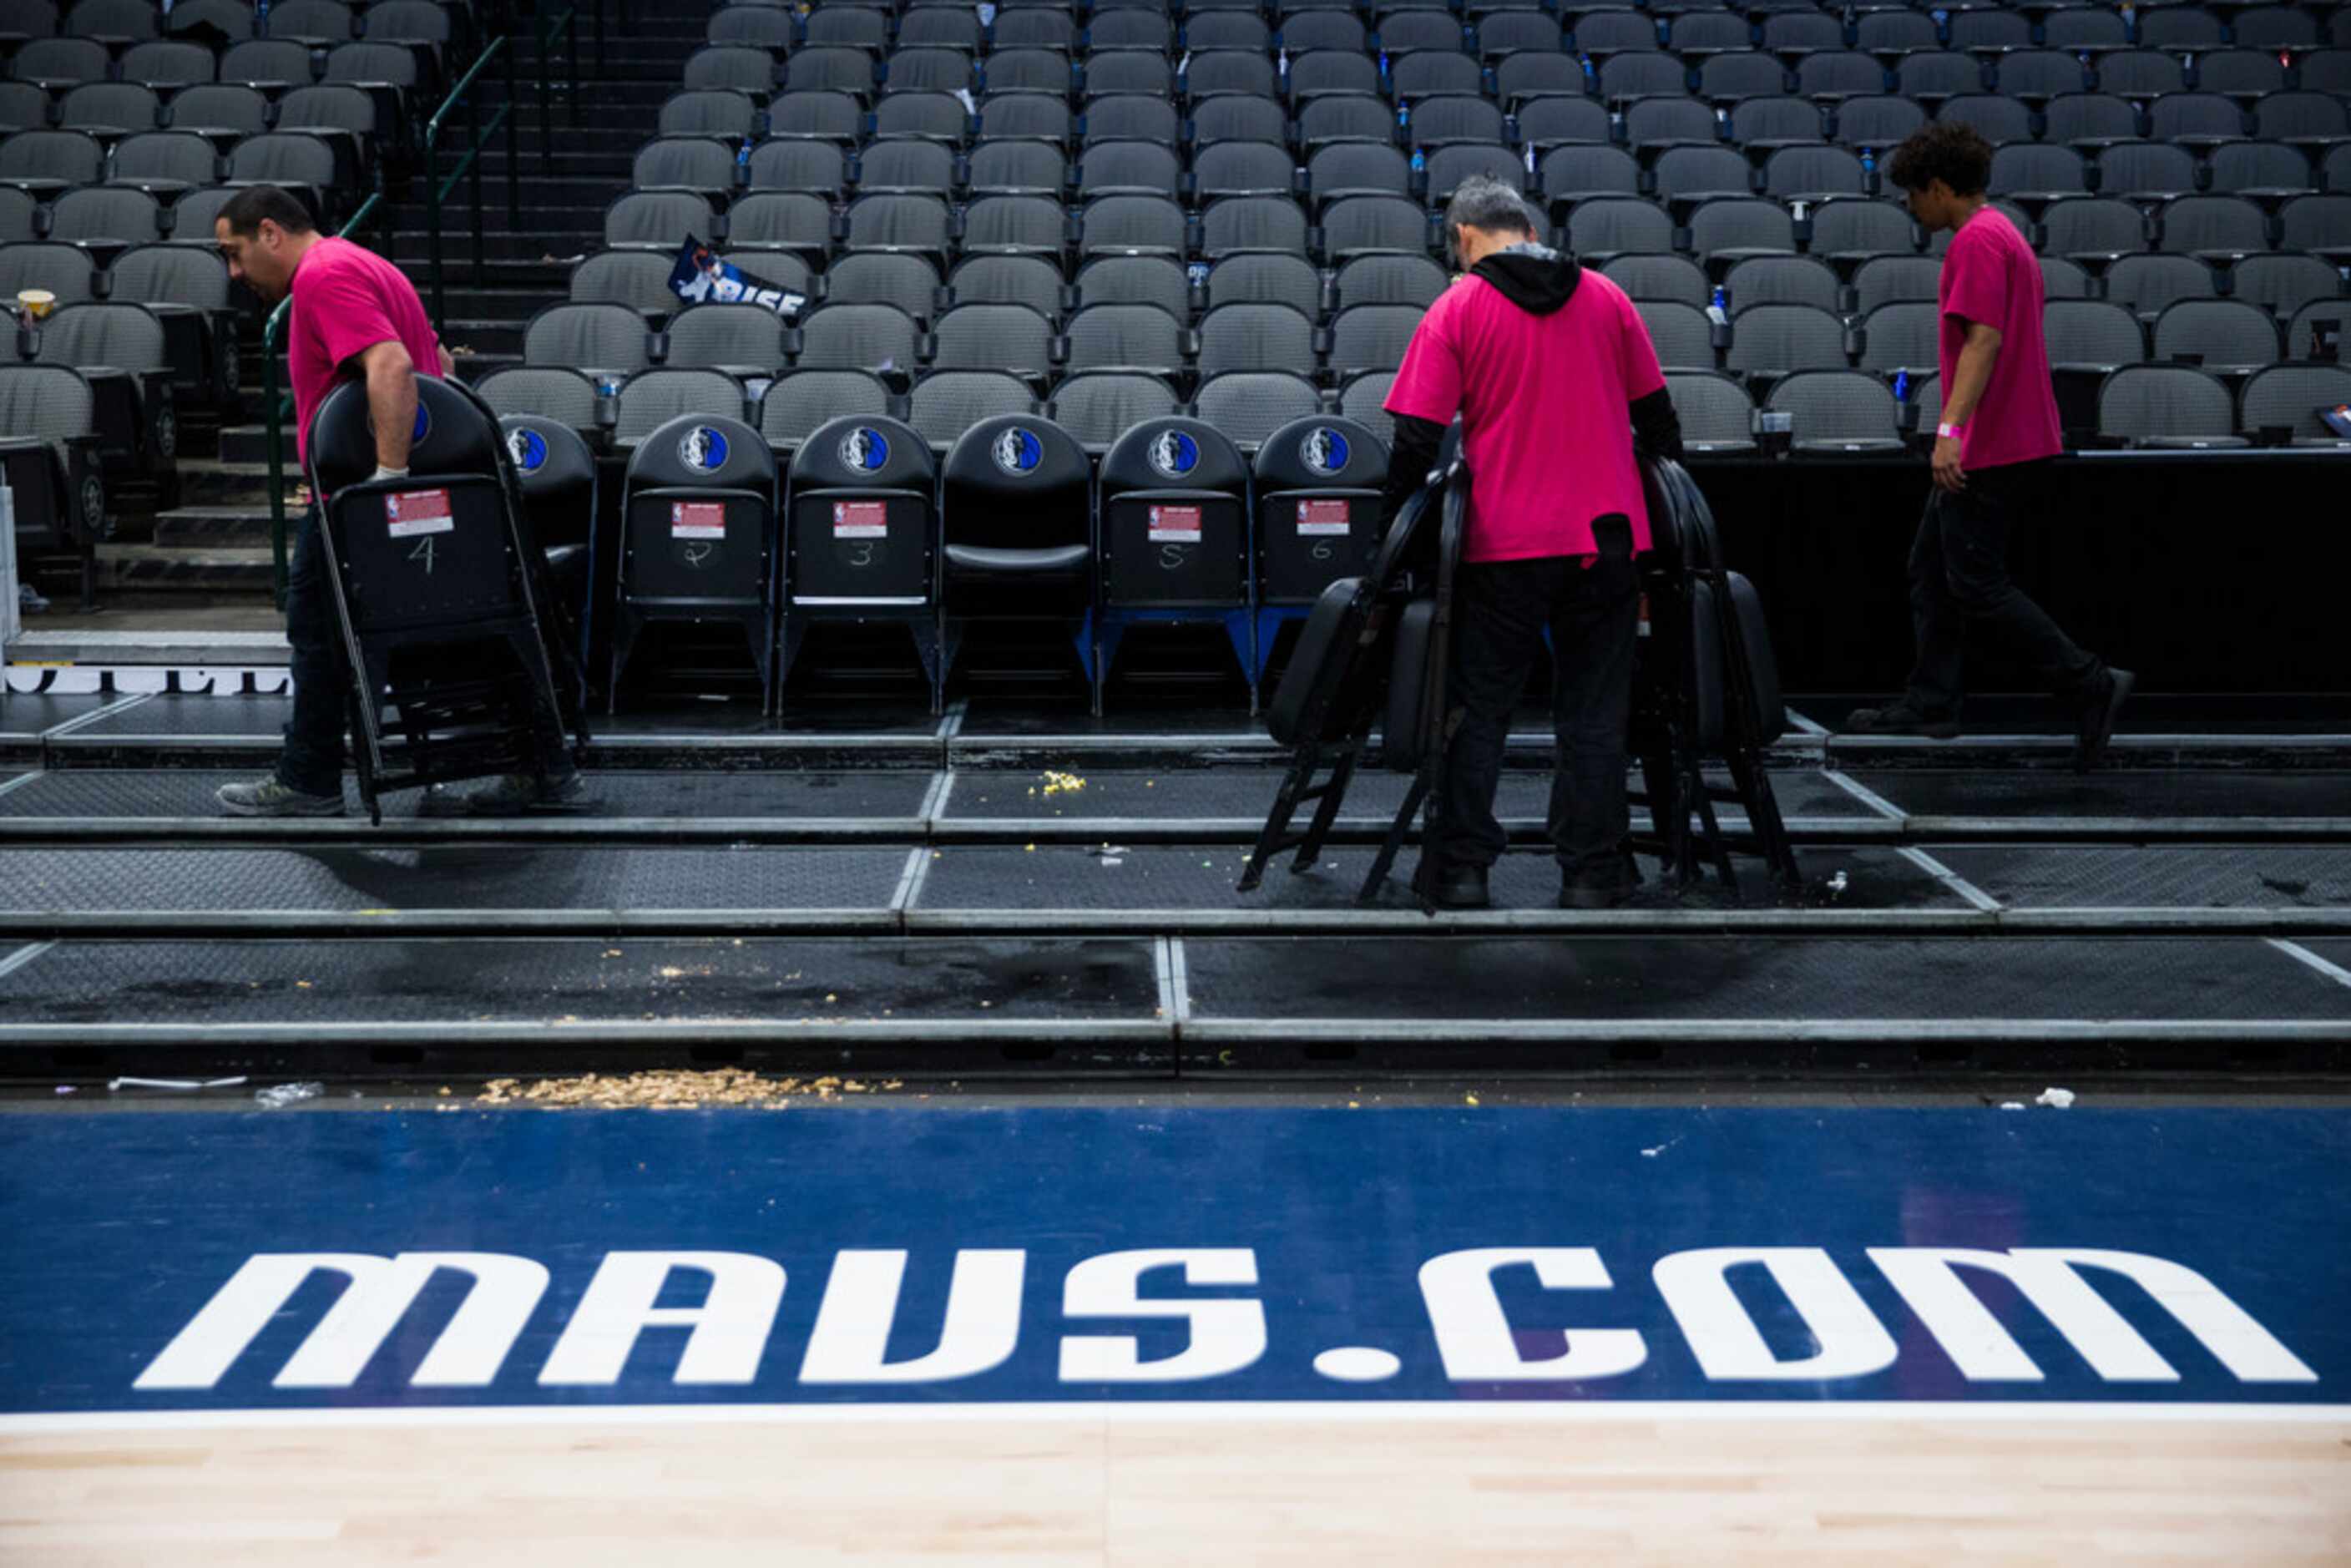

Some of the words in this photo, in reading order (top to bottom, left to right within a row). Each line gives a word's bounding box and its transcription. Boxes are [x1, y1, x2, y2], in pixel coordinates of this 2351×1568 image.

[408, 535, 439, 574] 4
[849, 541, 873, 566] 3
[1312, 539, 1334, 559] 6
[134, 1247, 2317, 1388] MAVS.COM
